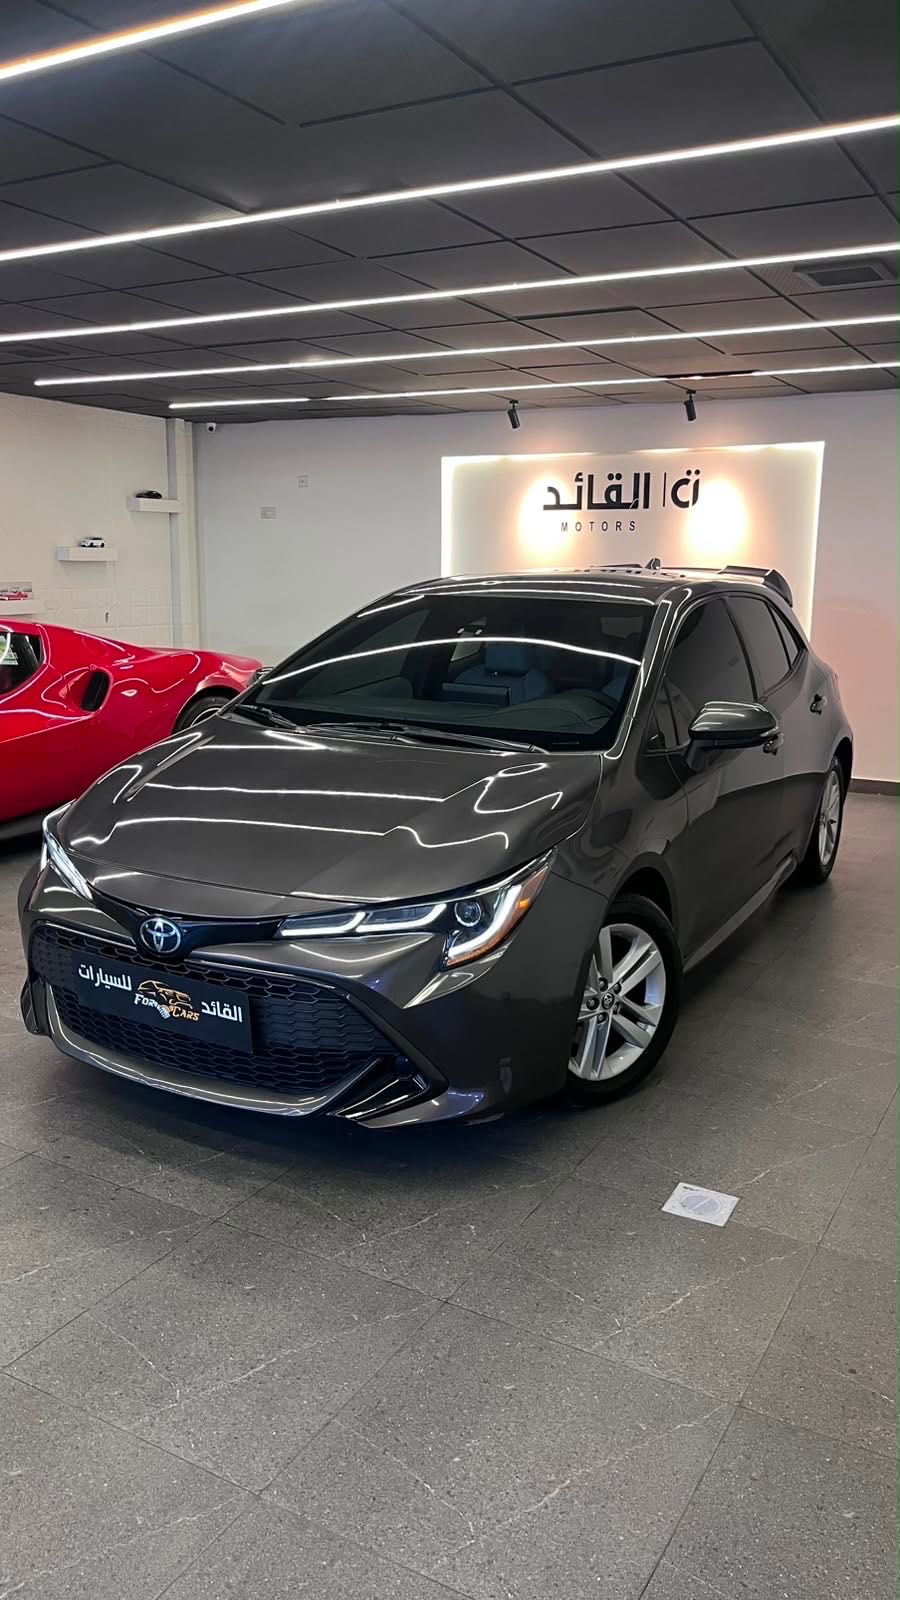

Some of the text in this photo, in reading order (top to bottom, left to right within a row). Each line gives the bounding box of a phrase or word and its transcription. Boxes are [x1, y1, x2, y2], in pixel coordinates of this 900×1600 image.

[543, 471, 651, 510] القائد
[560, 521, 636, 532] MOTORS
[78, 964, 243, 1023] القائد للسيارات
[172, 1005, 200, 1021] CARS
